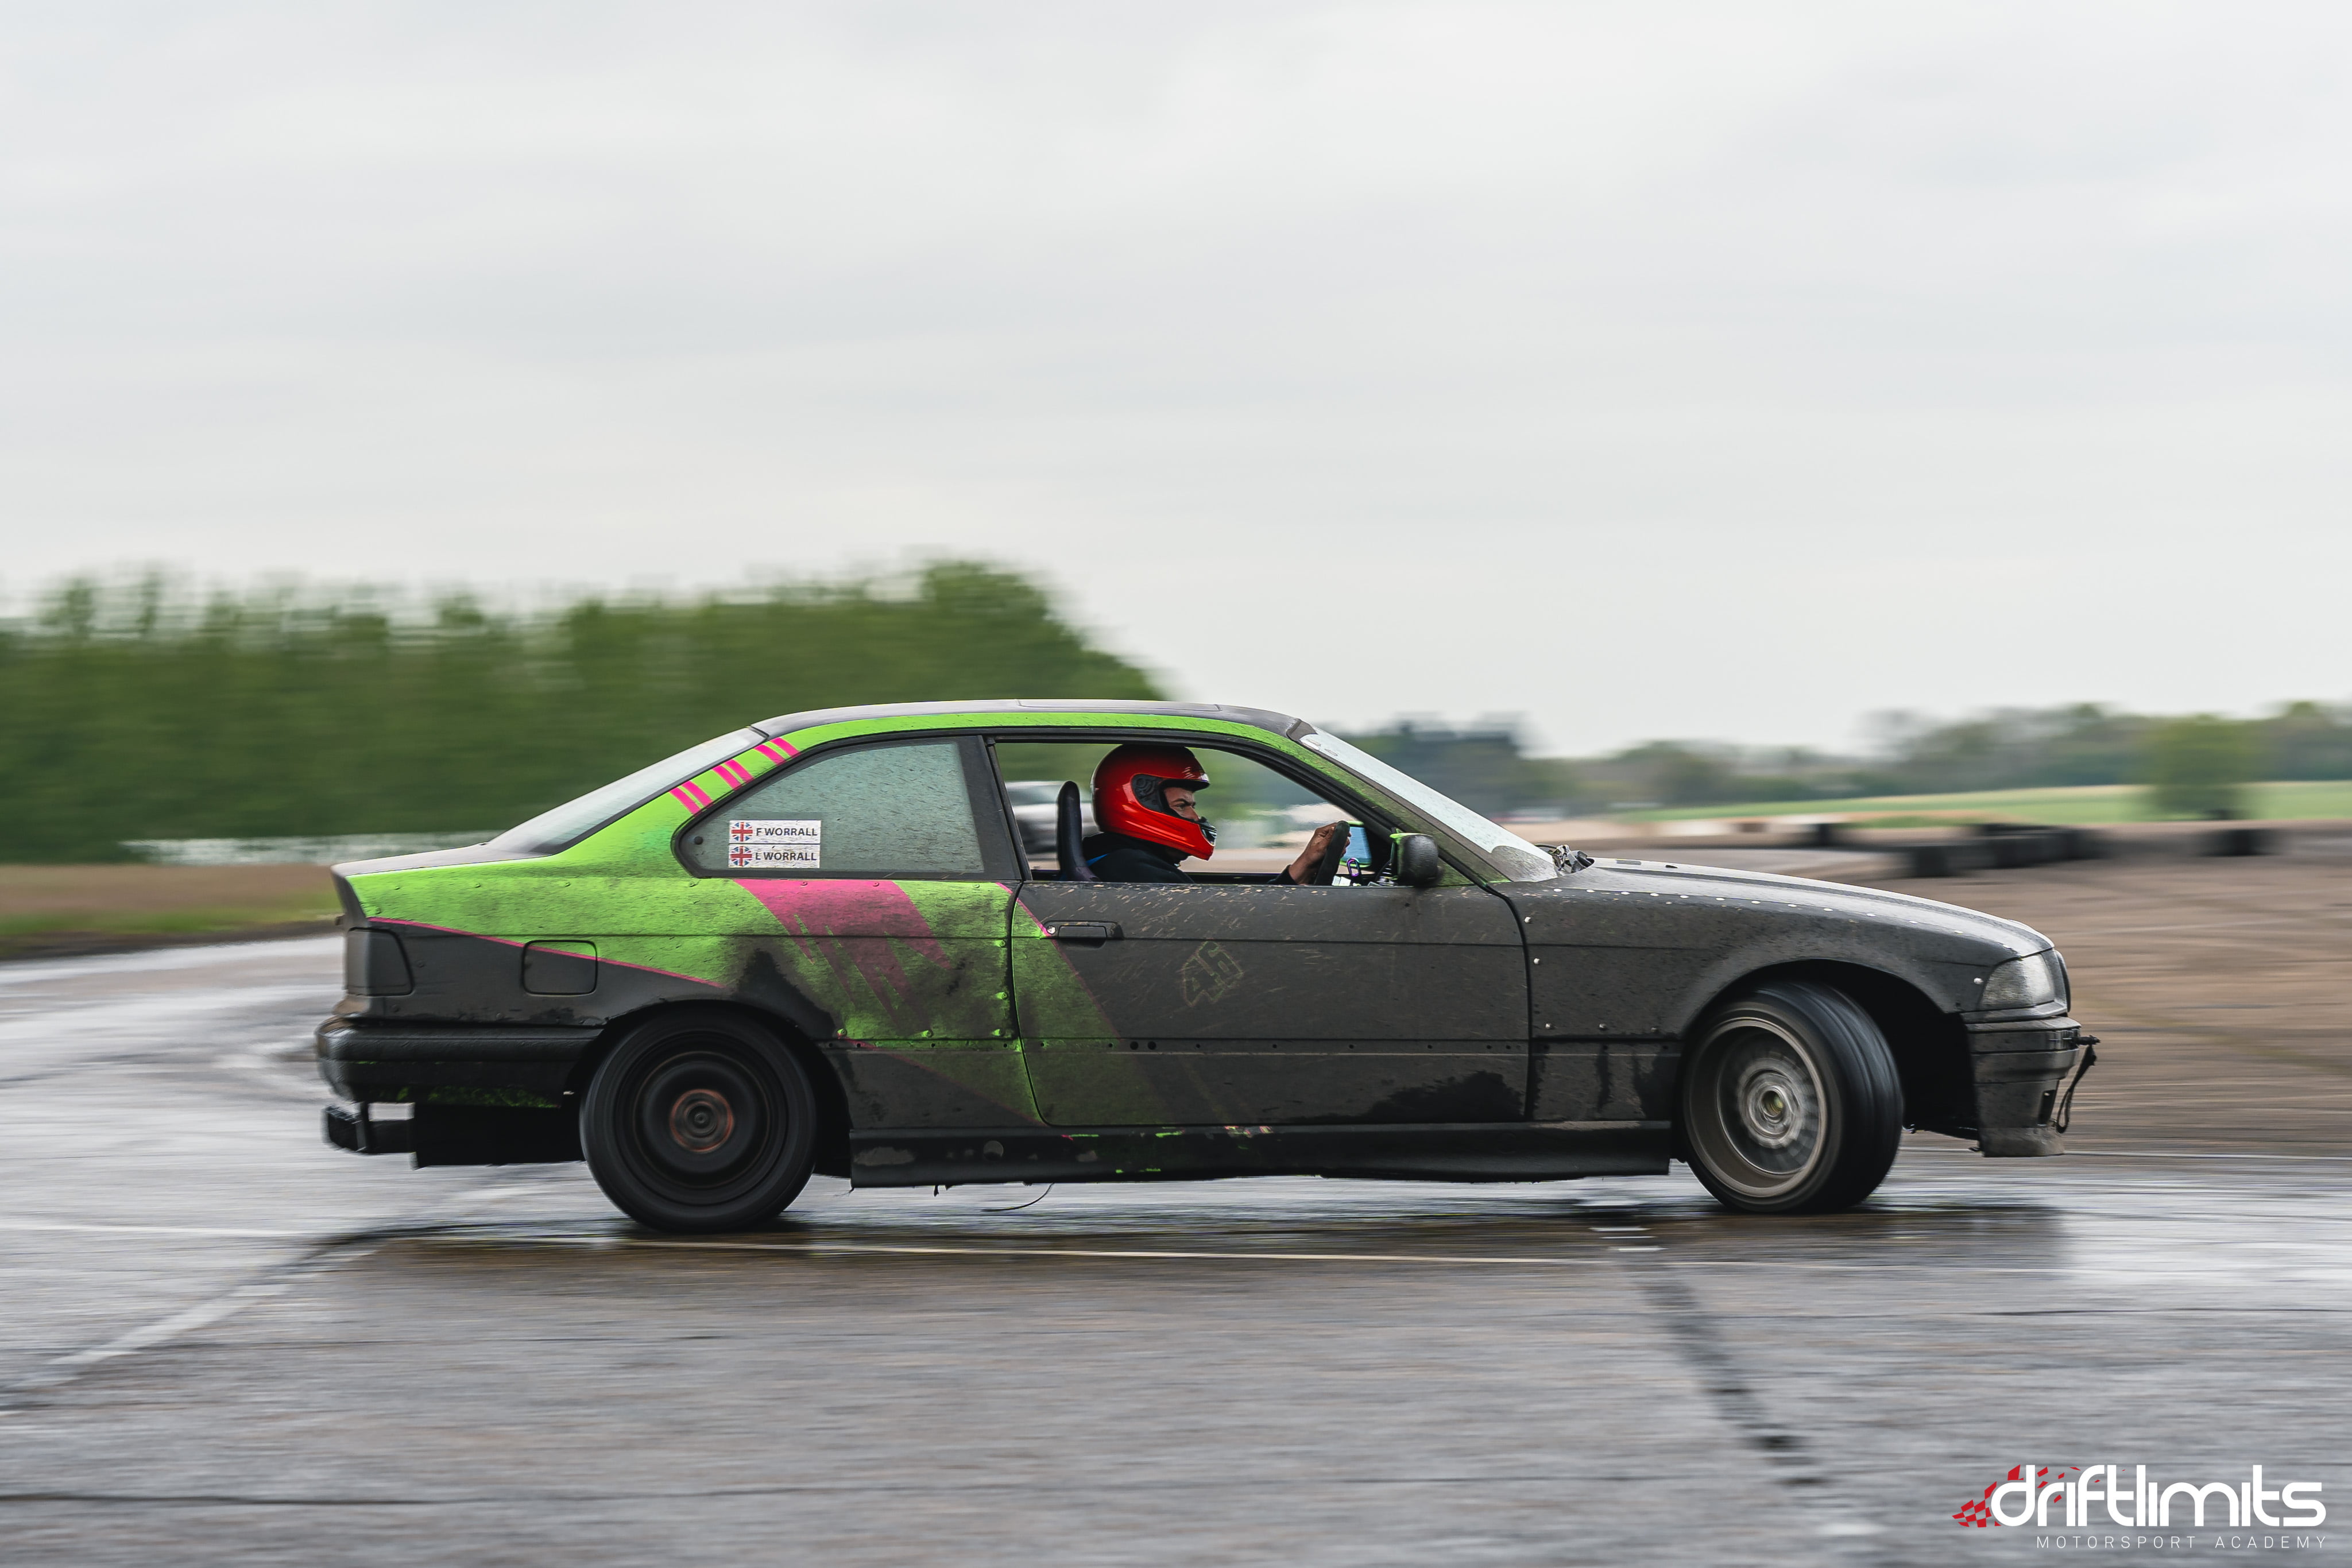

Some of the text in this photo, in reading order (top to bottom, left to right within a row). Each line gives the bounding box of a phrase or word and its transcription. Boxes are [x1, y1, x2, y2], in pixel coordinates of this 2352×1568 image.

[756, 827, 818, 837] F WORRALL
[755, 851, 817, 861] L WORRALL
